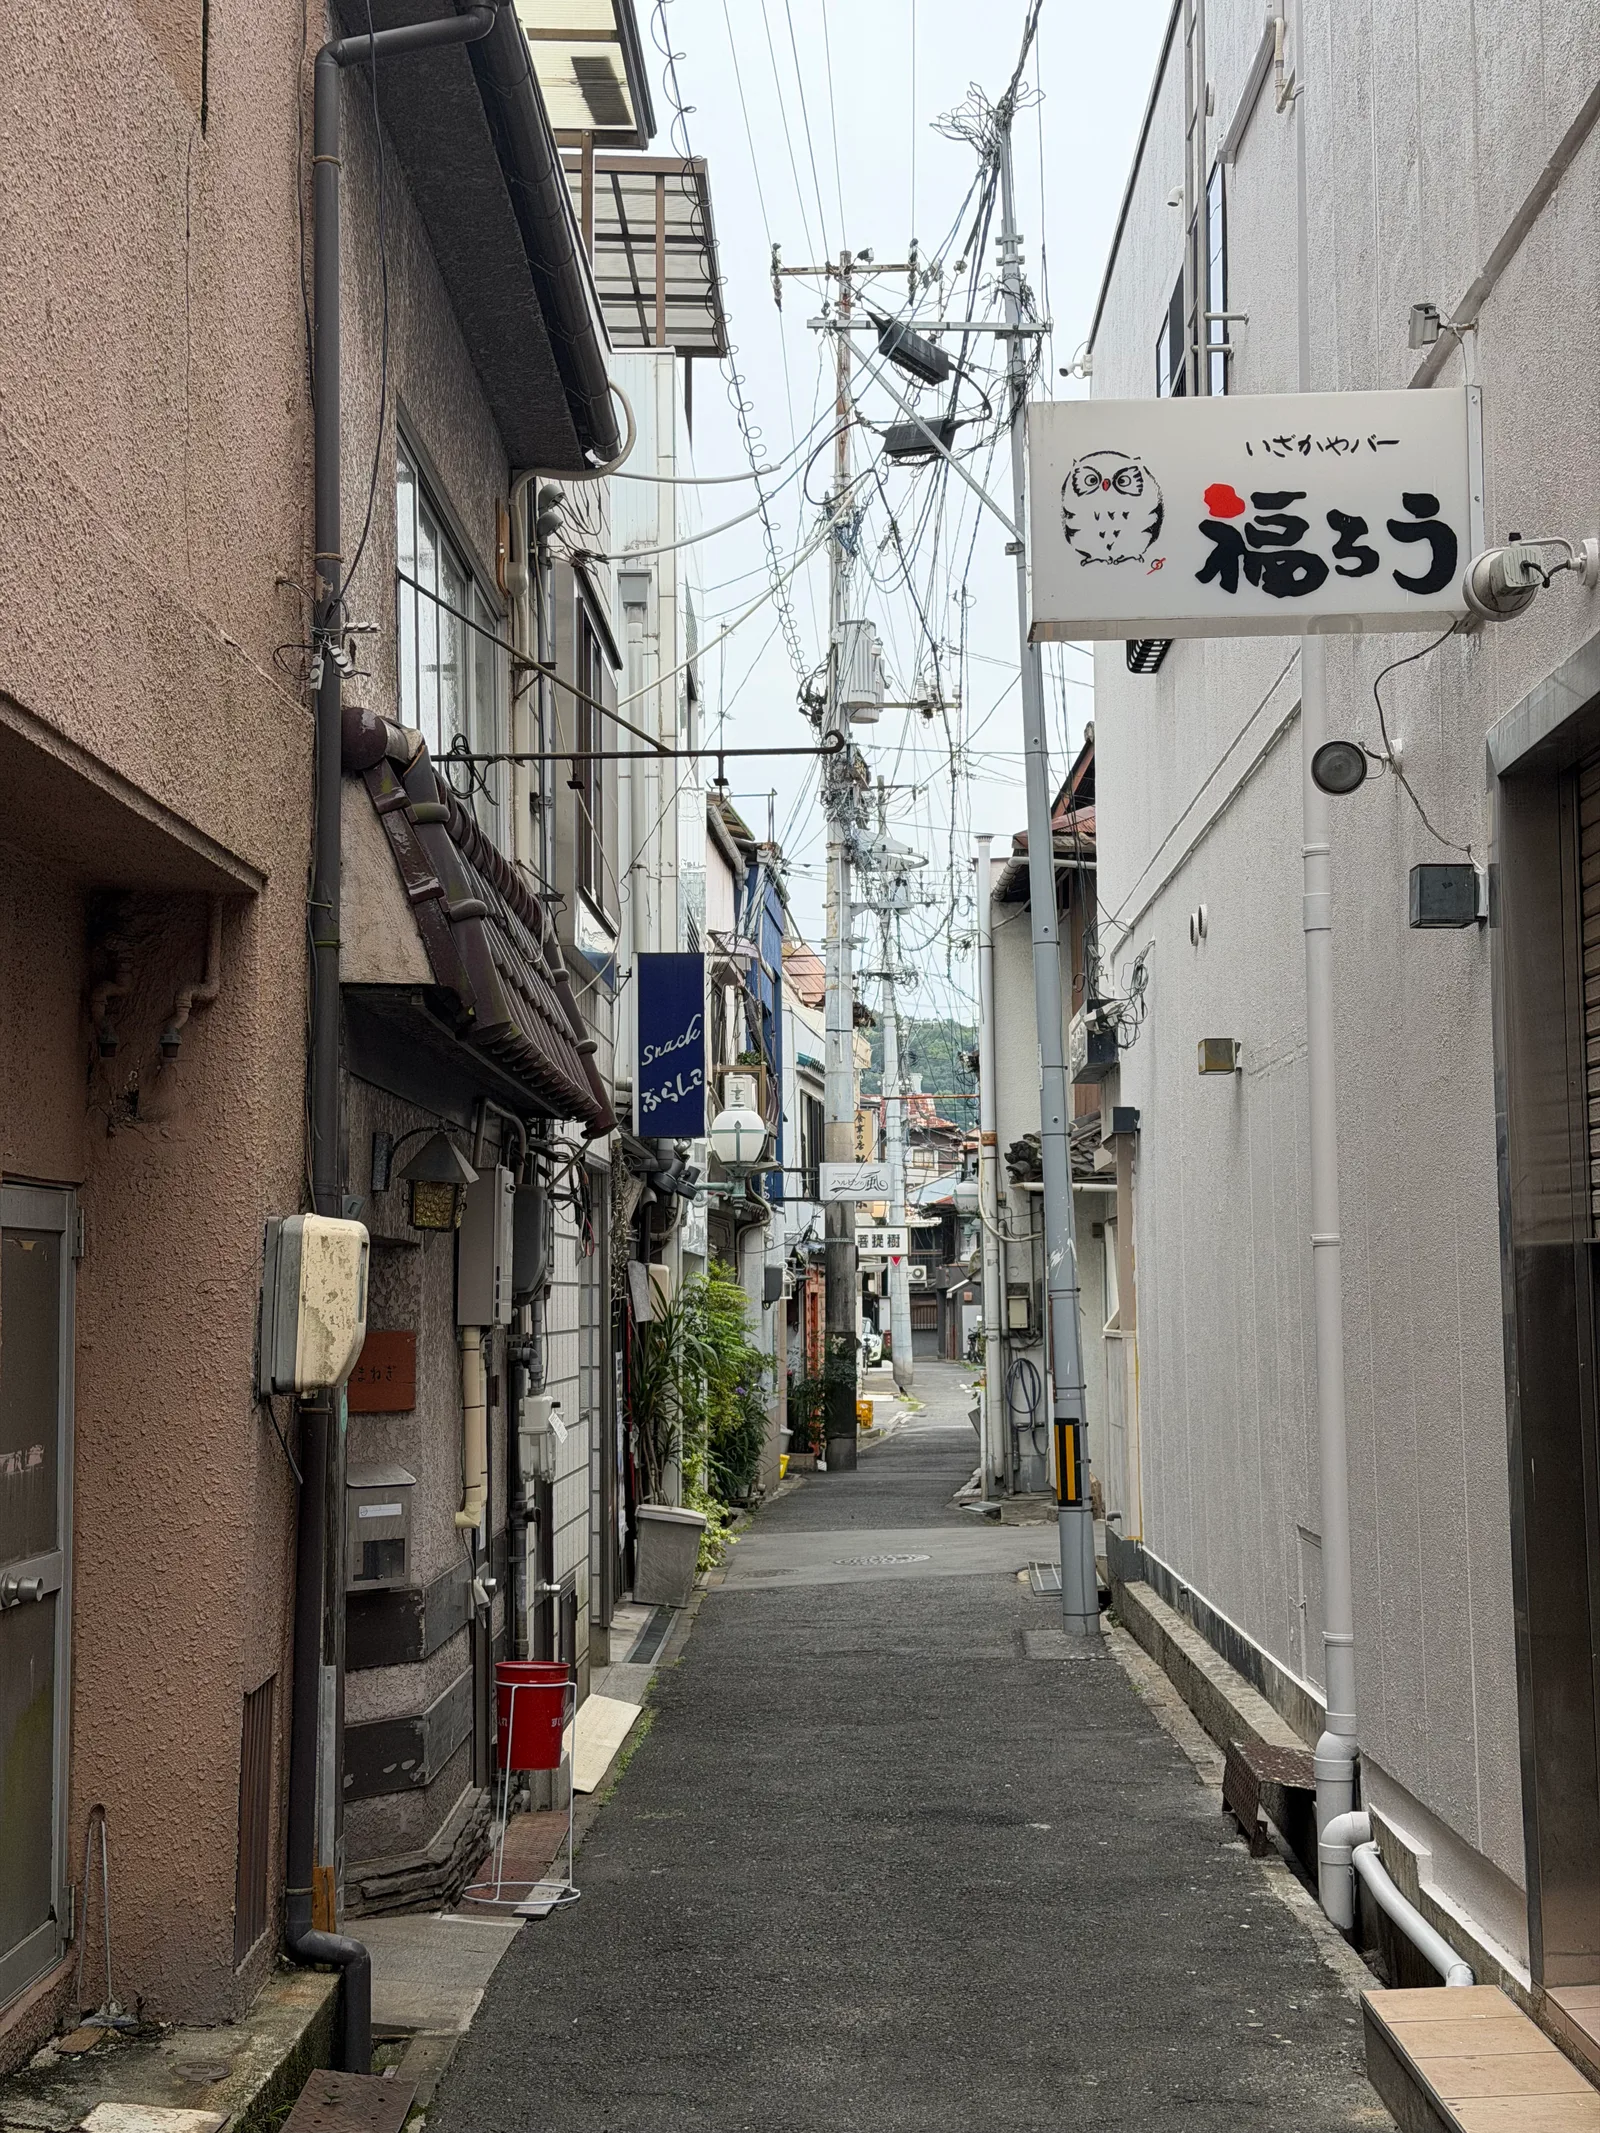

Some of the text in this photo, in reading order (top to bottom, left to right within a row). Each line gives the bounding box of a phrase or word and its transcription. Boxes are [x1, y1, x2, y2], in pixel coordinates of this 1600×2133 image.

[1245, 433, 1400, 458] いざかやバー
[1194, 482, 1458, 599] 福ろう
[641, 1013, 702, 1066] Snack
[857, 1233, 901, 1249] 菩提樹
